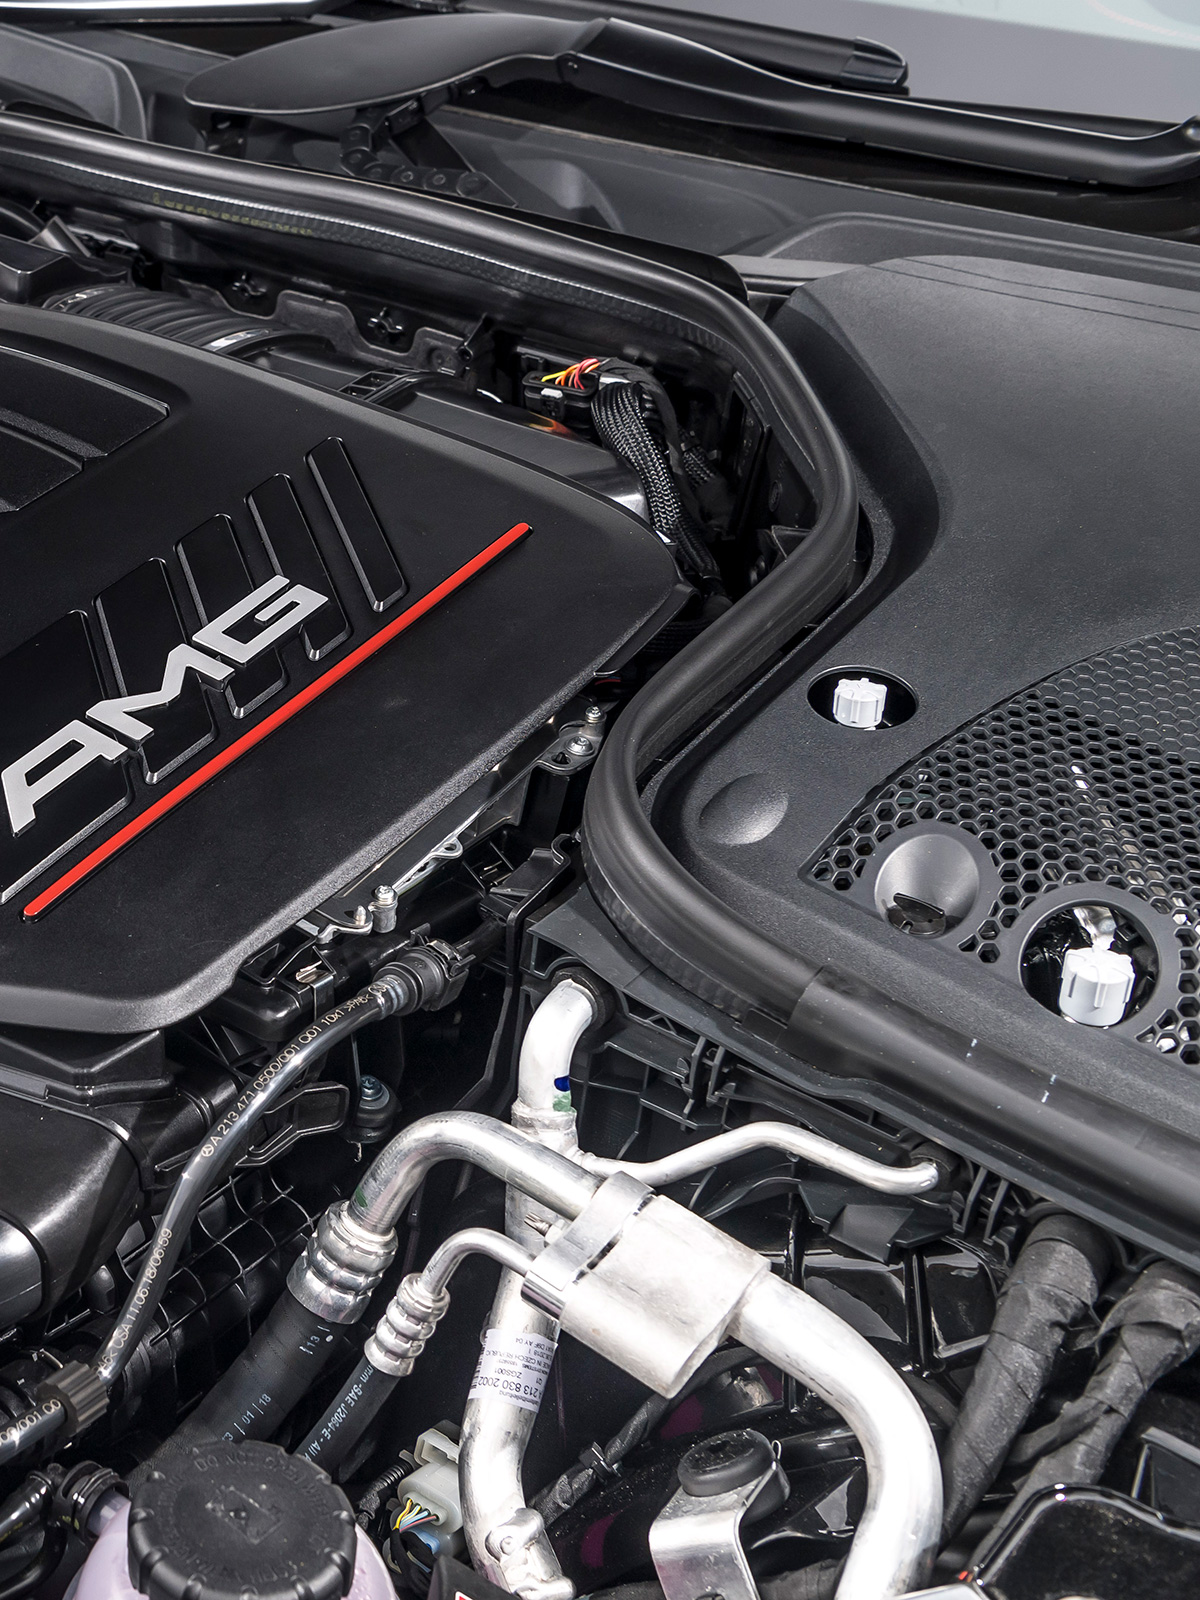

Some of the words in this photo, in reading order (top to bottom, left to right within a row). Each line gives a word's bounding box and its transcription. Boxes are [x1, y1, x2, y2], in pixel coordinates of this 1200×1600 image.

[1, 574, 329, 836] AMG
[217, 1109, 240, 1136] 213
[236, 1090, 256, 1112] 471
[253, 1043, 301, 1092] 0500/001
[477, 1375, 500, 1389] 2002
[502, 1379, 522, 1393] 830
[523, 1384, 539, 1399] 213
[258, 1392, 272, 1408] 18
